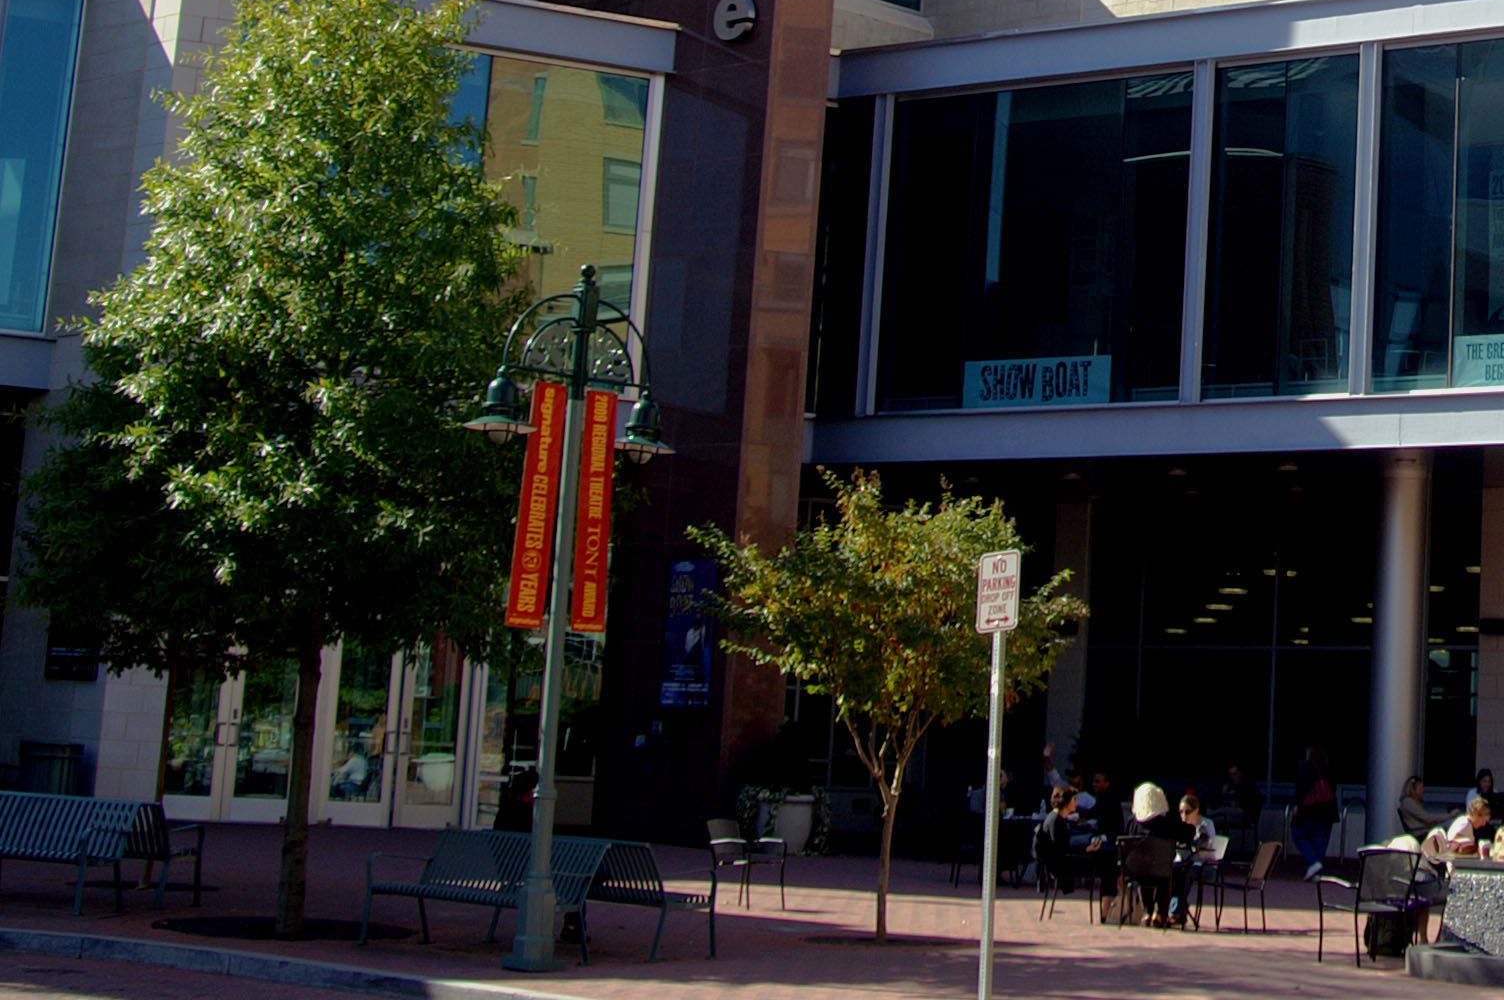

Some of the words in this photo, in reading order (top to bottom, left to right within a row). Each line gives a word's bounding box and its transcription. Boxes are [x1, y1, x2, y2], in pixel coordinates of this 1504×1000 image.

[1466, 343, 1483, 360] THE
[979, 362, 1037, 401] SHOW
[1041, 360, 1092, 402] BOAT
[593, 394, 608, 422] 2009
[538, 387, 555, 473] signature
[590, 424, 607, 473] REGIONAL
[525, 474, 549, 549] CELEBRATES
[588, 477, 605, 519] THEATRE
[584, 524, 601, 578] TONY
[992, 560, 1007, 574] NO
[517, 573, 539, 612] YEARS
[582, 581, 597, 617] AWARD
[983, 575, 1016, 592] PARKING
[1001, 591, 1015, 602] OFF
[988, 603, 1007, 615] ZONE
